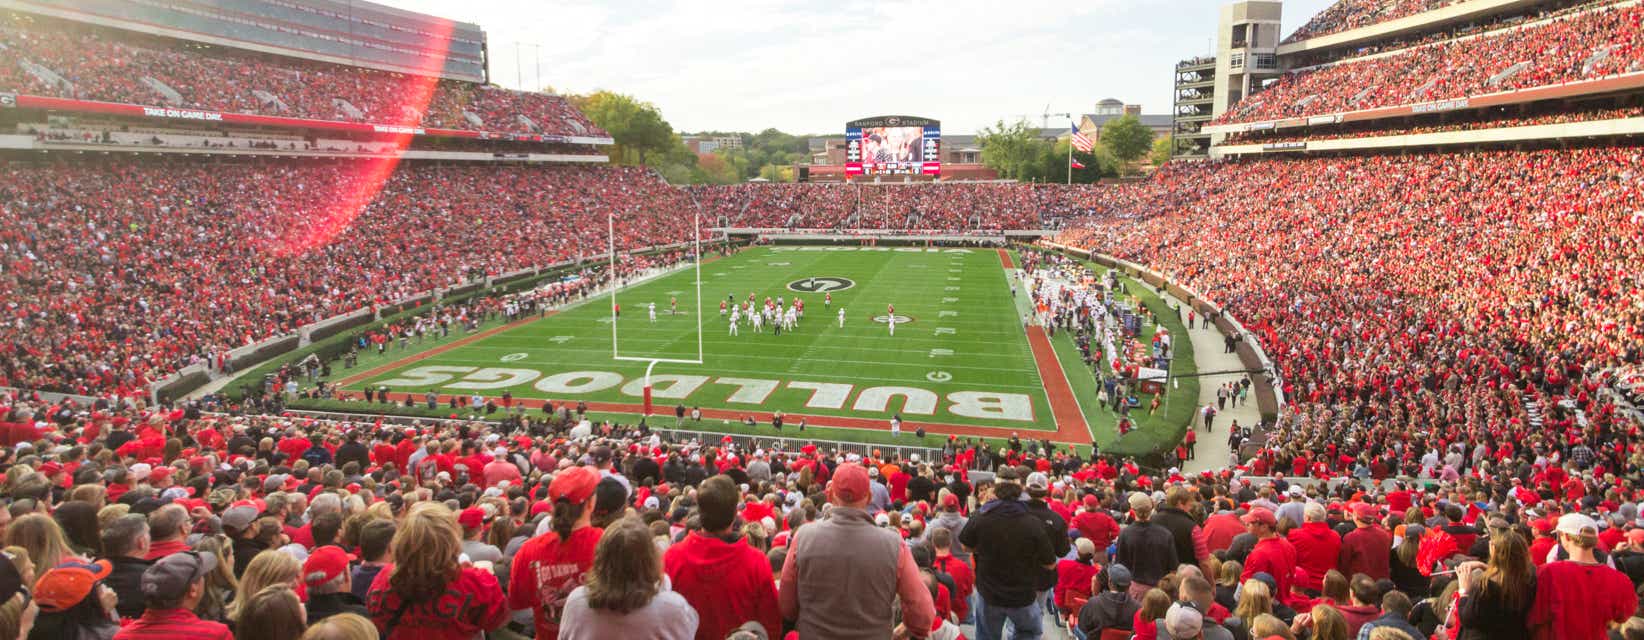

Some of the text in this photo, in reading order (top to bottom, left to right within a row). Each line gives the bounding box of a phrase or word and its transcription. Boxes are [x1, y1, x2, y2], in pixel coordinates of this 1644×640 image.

[144, 107, 166, 117] TAKE
[166, 109, 180, 118] ON
[181, 110, 204, 120] GAME
[371, 365, 1037, 421] BULLDOGS
